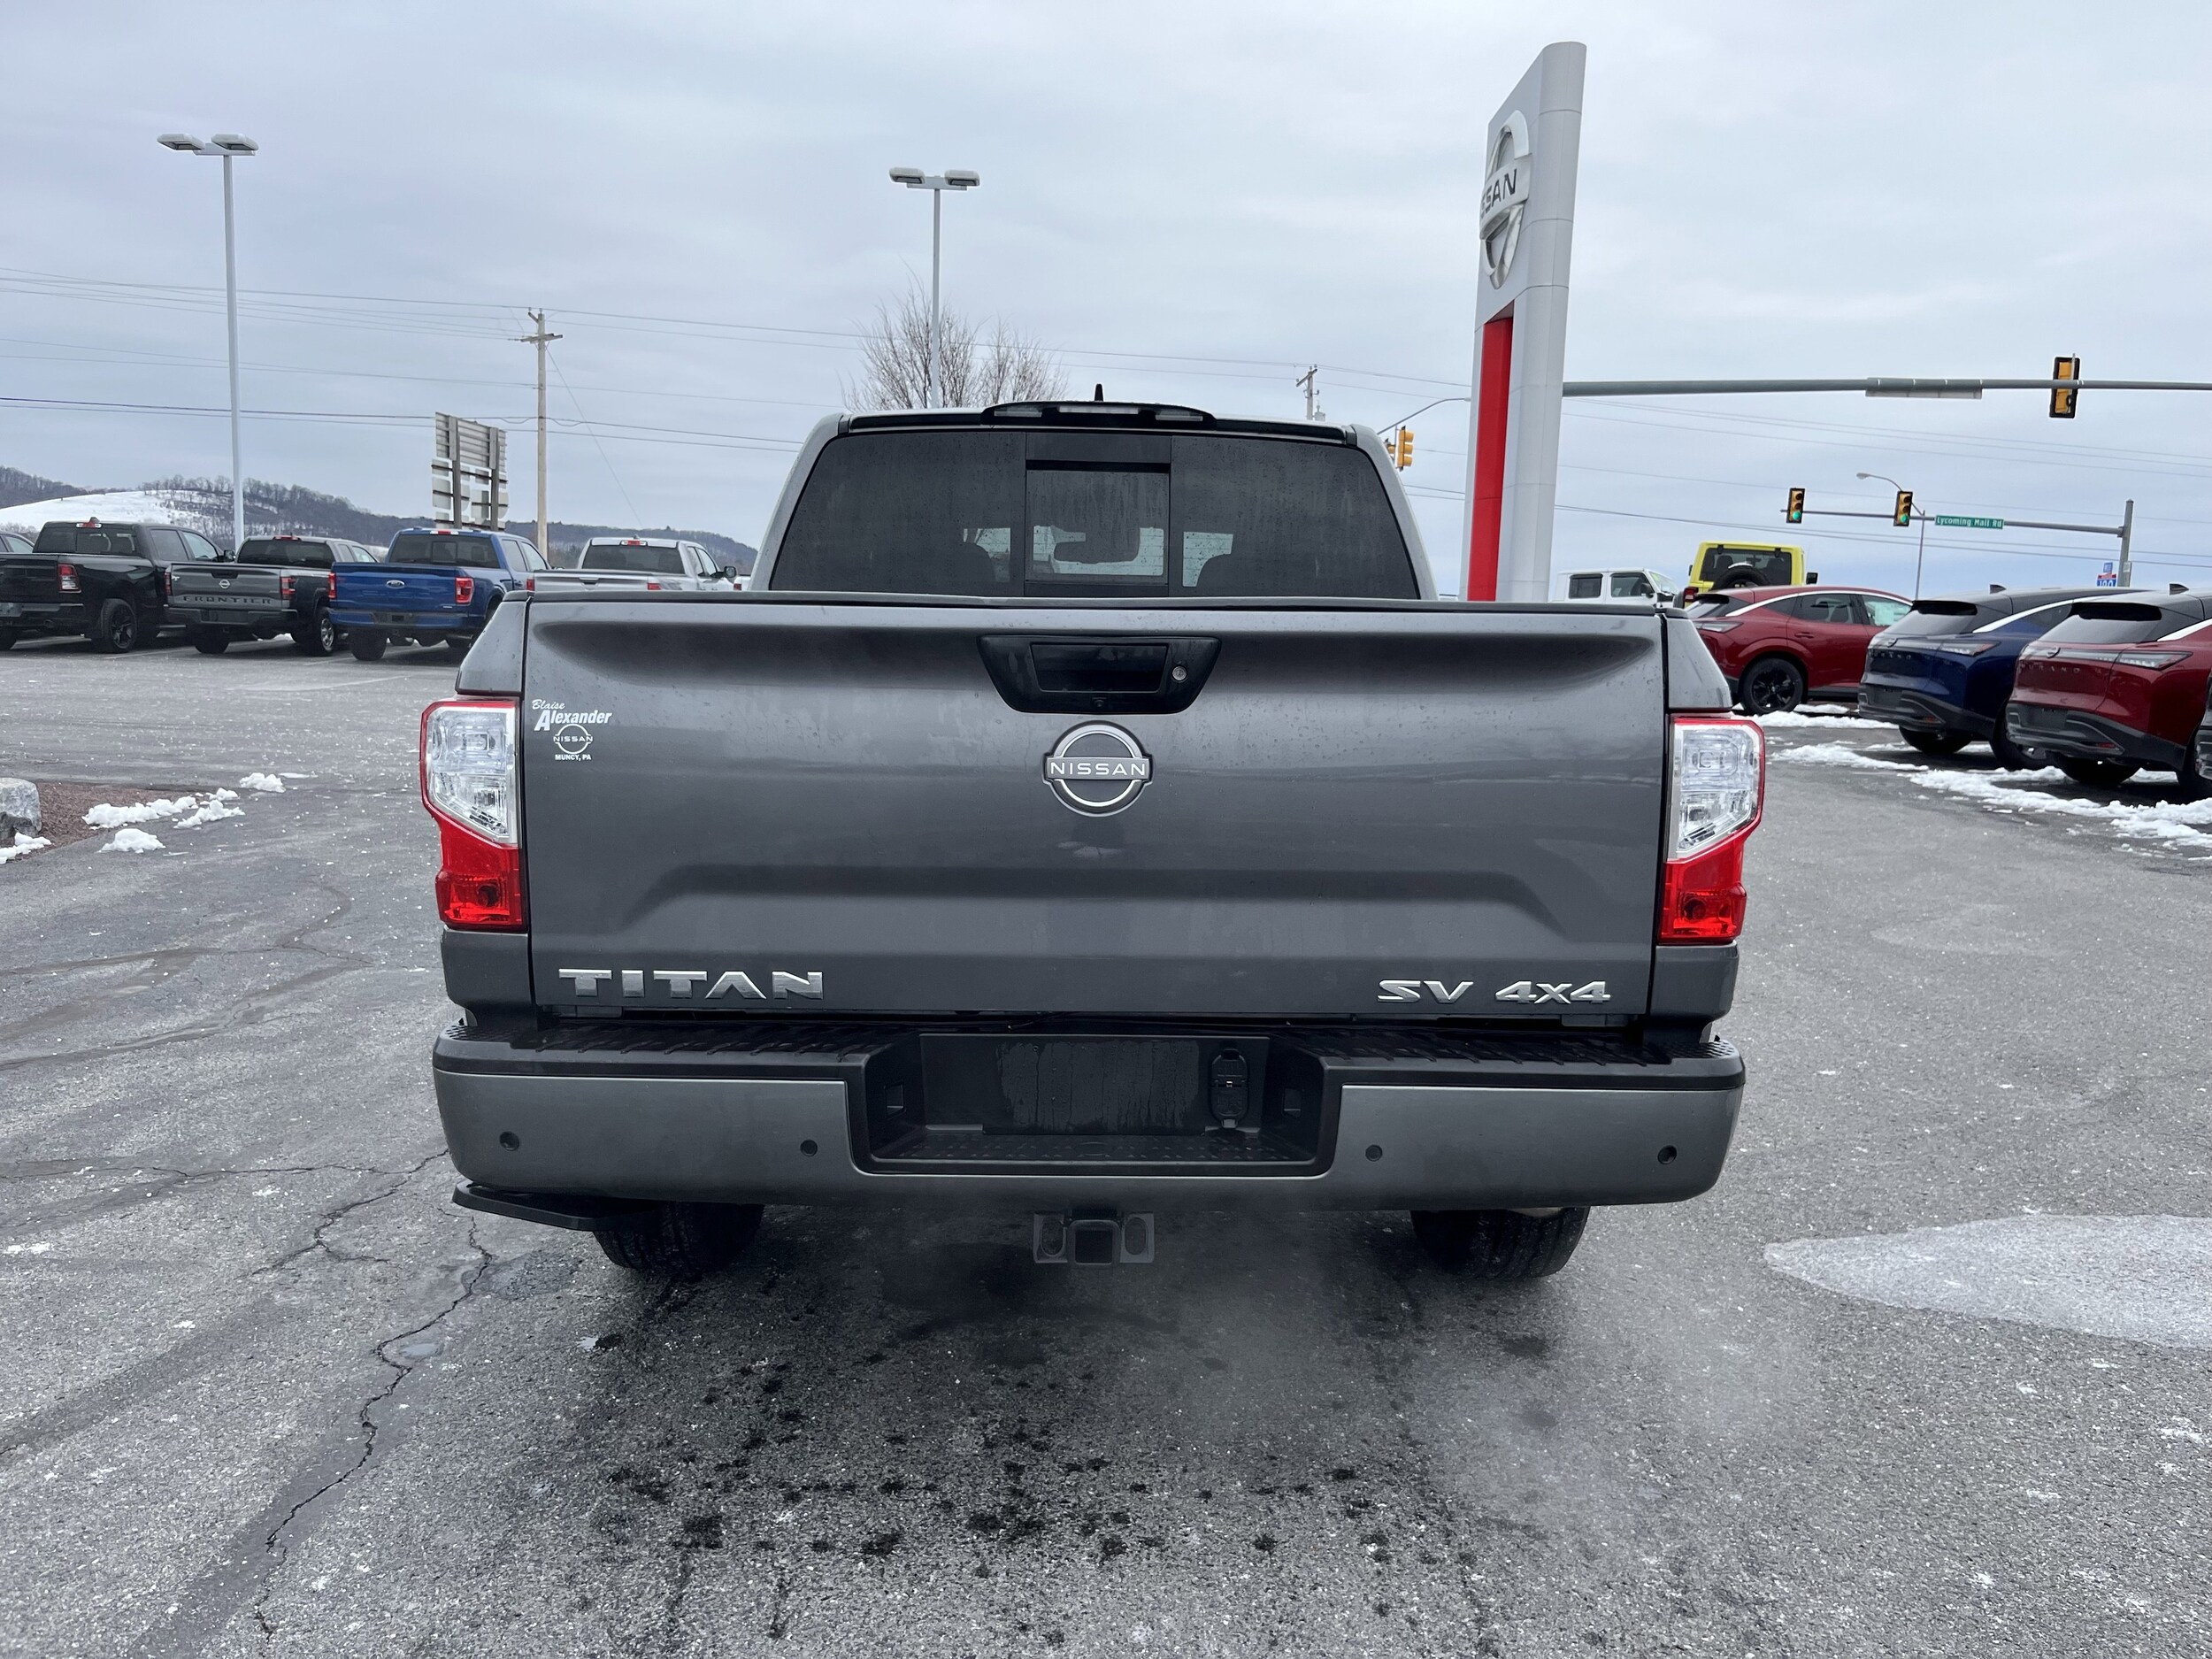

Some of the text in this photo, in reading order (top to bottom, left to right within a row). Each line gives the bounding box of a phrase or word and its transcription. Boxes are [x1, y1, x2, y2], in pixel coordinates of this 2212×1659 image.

[1480, 168, 1517, 219] SSAN
[1937, 516, 2002, 528] Lycoming Mall Rd
[183, 595, 272, 605] FRONTIER
[532, 699, 565, 710] Blaise
[534, 710, 612, 731] Alexander
[1050, 762, 1145, 776] NISSAN
[558, 968, 824, 1000] TITAN
[1377, 979, 1474, 1004] SV
